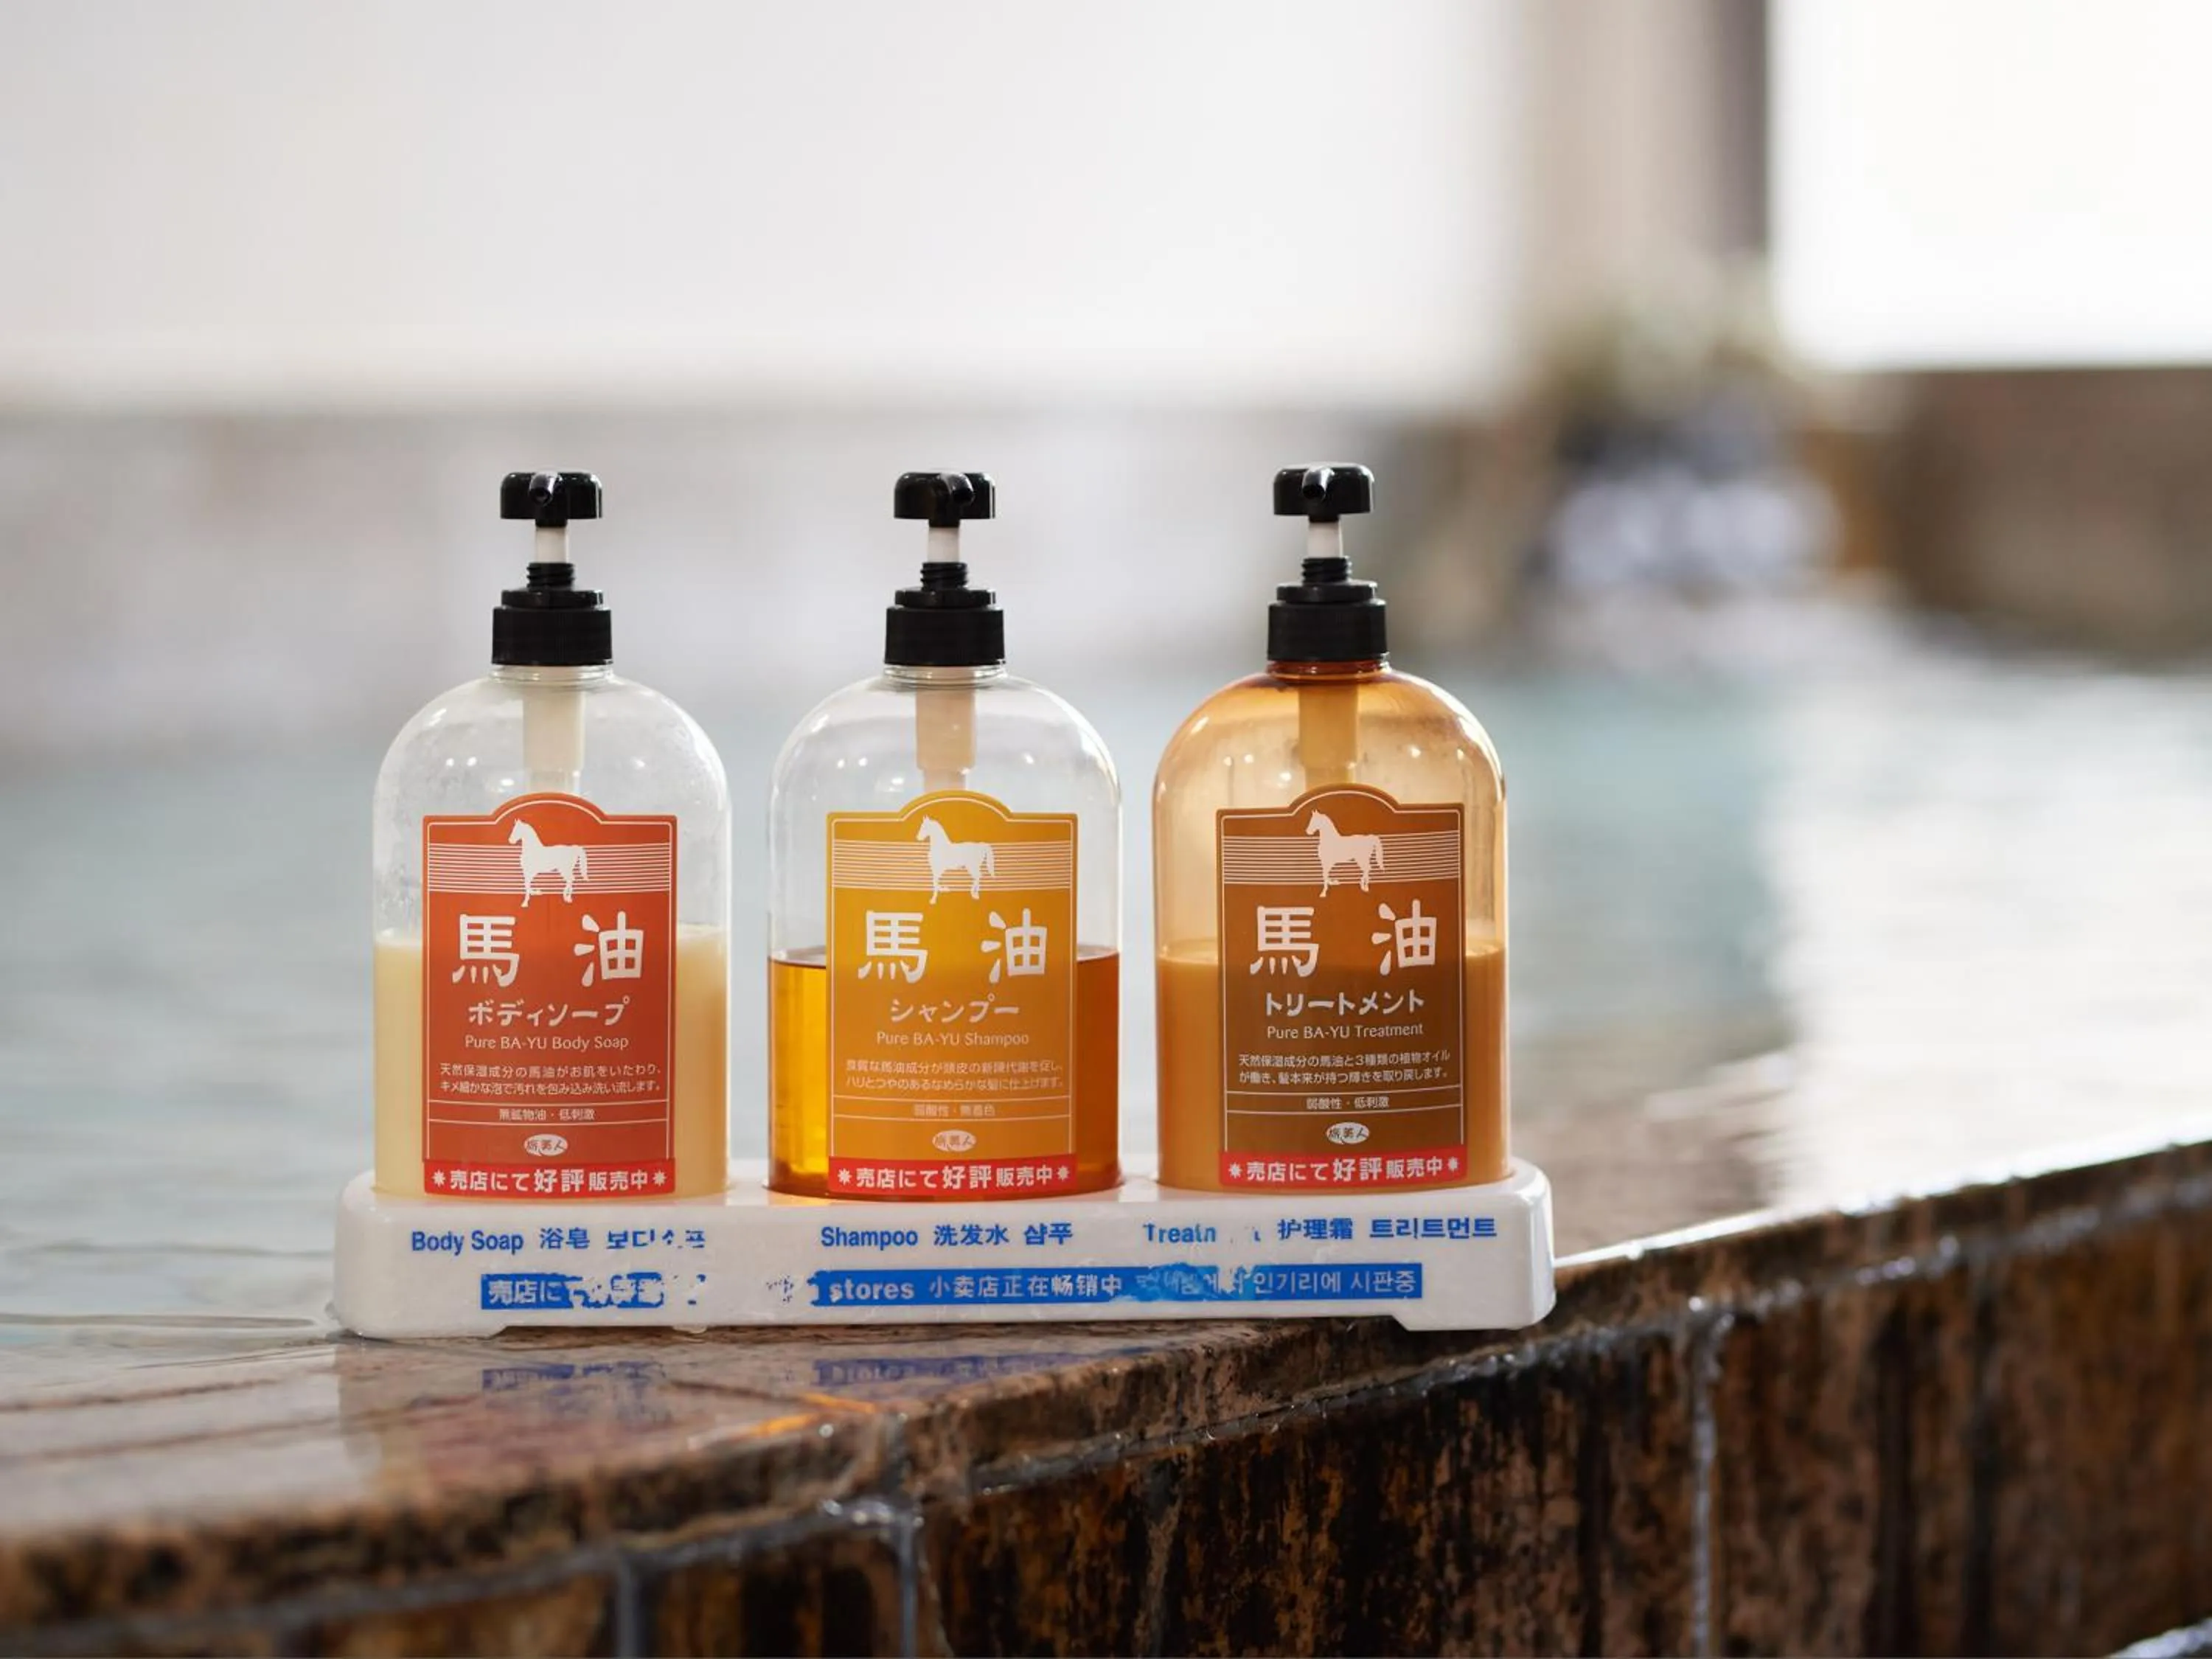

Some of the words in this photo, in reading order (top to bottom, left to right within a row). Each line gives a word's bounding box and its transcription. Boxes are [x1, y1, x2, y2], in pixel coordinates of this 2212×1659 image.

[467, 995, 630, 1026] ボディソープ
[889, 992, 1020, 1023] シャンプー
[1265, 988, 1425, 1017] トリートメント
[876, 1032, 909, 1046] Pure
[913, 1032, 960, 1046] BA-YU
[964, 1032, 1029, 1048] Shampoo
[1267, 1025, 1298, 1039] Pure
[1303, 1025, 1350, 1039] BA-YU
[1355, 1023, 1424, 1038] Treatment
[465, 1034, 496, 1049] Pure
[501, 1035, 547, 1050] BA-YU
[552, 1035, 590, 1053] Body
[594, 1034, 630, 1051] Soap
[539, 1227, 589, 1250] 浴皂
[821, 1226, 918, 1251] Shampoo
[933, 1224, 1009, 1245] 洗发水
[1023, 1222, 1072, 1245] 샴푸
[1277, 1218, 1353, 1240] 护理霜
[1369, 1218, 1498, 1239] 트리트먼트
[411, 1231, 464, 1255] Body
[470, 1231, 523, 1254] Soap
[829, 1279, 915, 1302] stores
[928, 1274, 1122, 1298] 小卖店正在畅销中
[1253, 1271, 1341, 1294] 인기리에
[1352, 1270, 1417, 1293] 시판중
